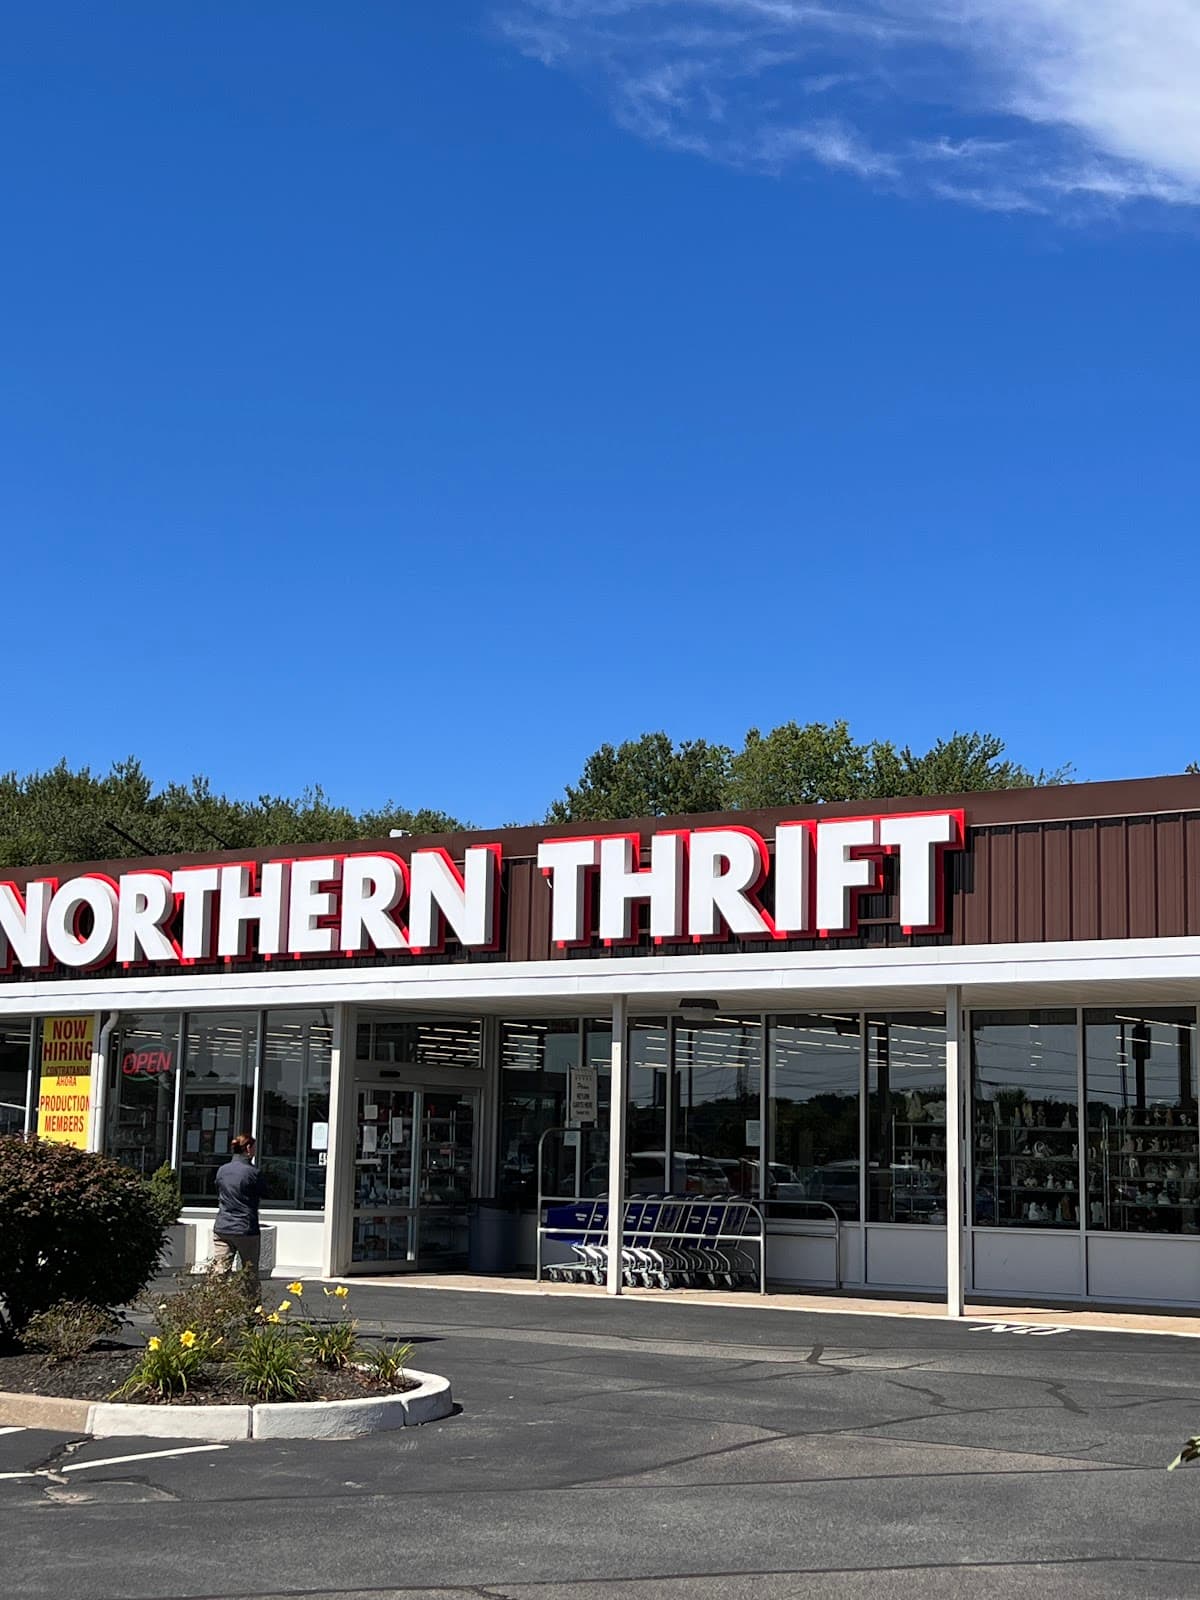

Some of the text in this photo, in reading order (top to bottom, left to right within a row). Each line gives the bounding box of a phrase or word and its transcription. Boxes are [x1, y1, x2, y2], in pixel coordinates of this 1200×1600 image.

[0, 814, 956, 967] NORTHERN THRIFT
[53, 1020, 87, 1040] NOW
[43, 1041, 93, 1061] HIRING
[122, 1051, 173, 1074] OPEN
[40, 1095, 90, 1111] PRODUCTION
[44, 1115, 84, 1132] MEMBERS
